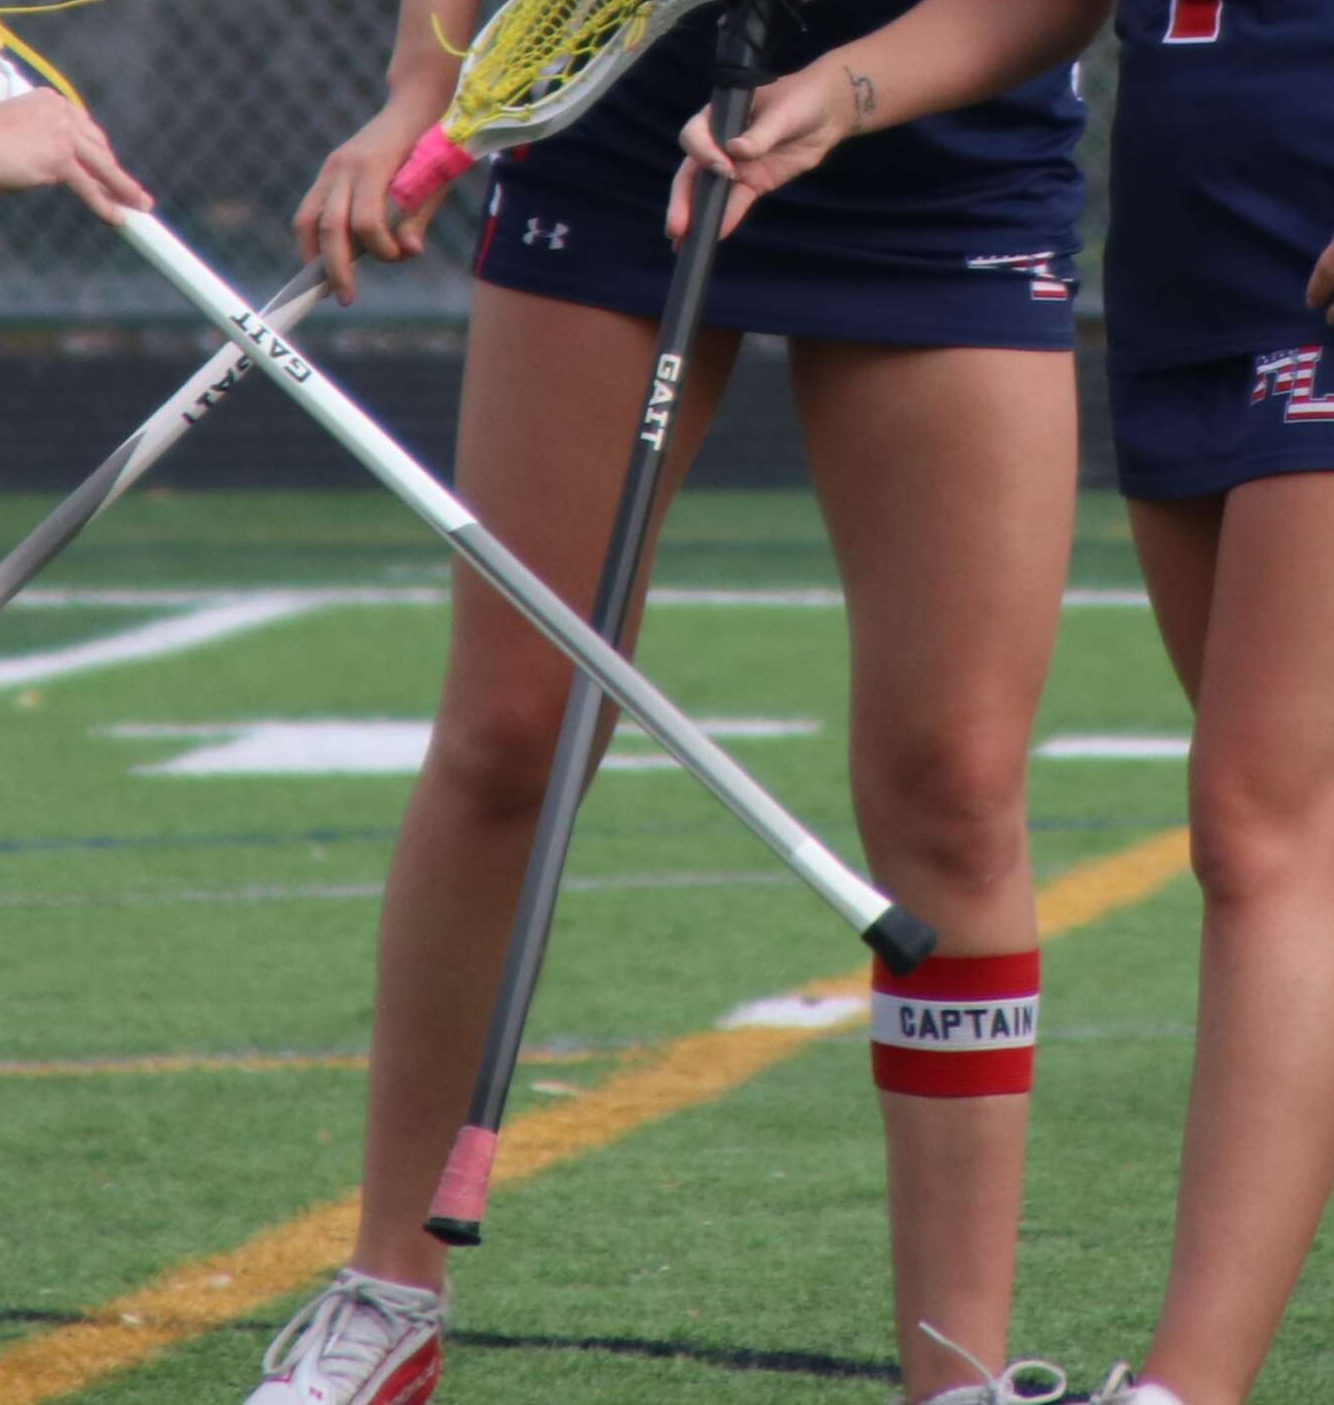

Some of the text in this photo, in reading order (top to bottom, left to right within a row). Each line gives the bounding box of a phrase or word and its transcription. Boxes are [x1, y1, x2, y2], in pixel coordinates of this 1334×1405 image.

[230, 311, 313, 384] GAIT
[640, 352, 682, 452] GAIT
[899, 1005, 1034, 1040] CAPTAIN
